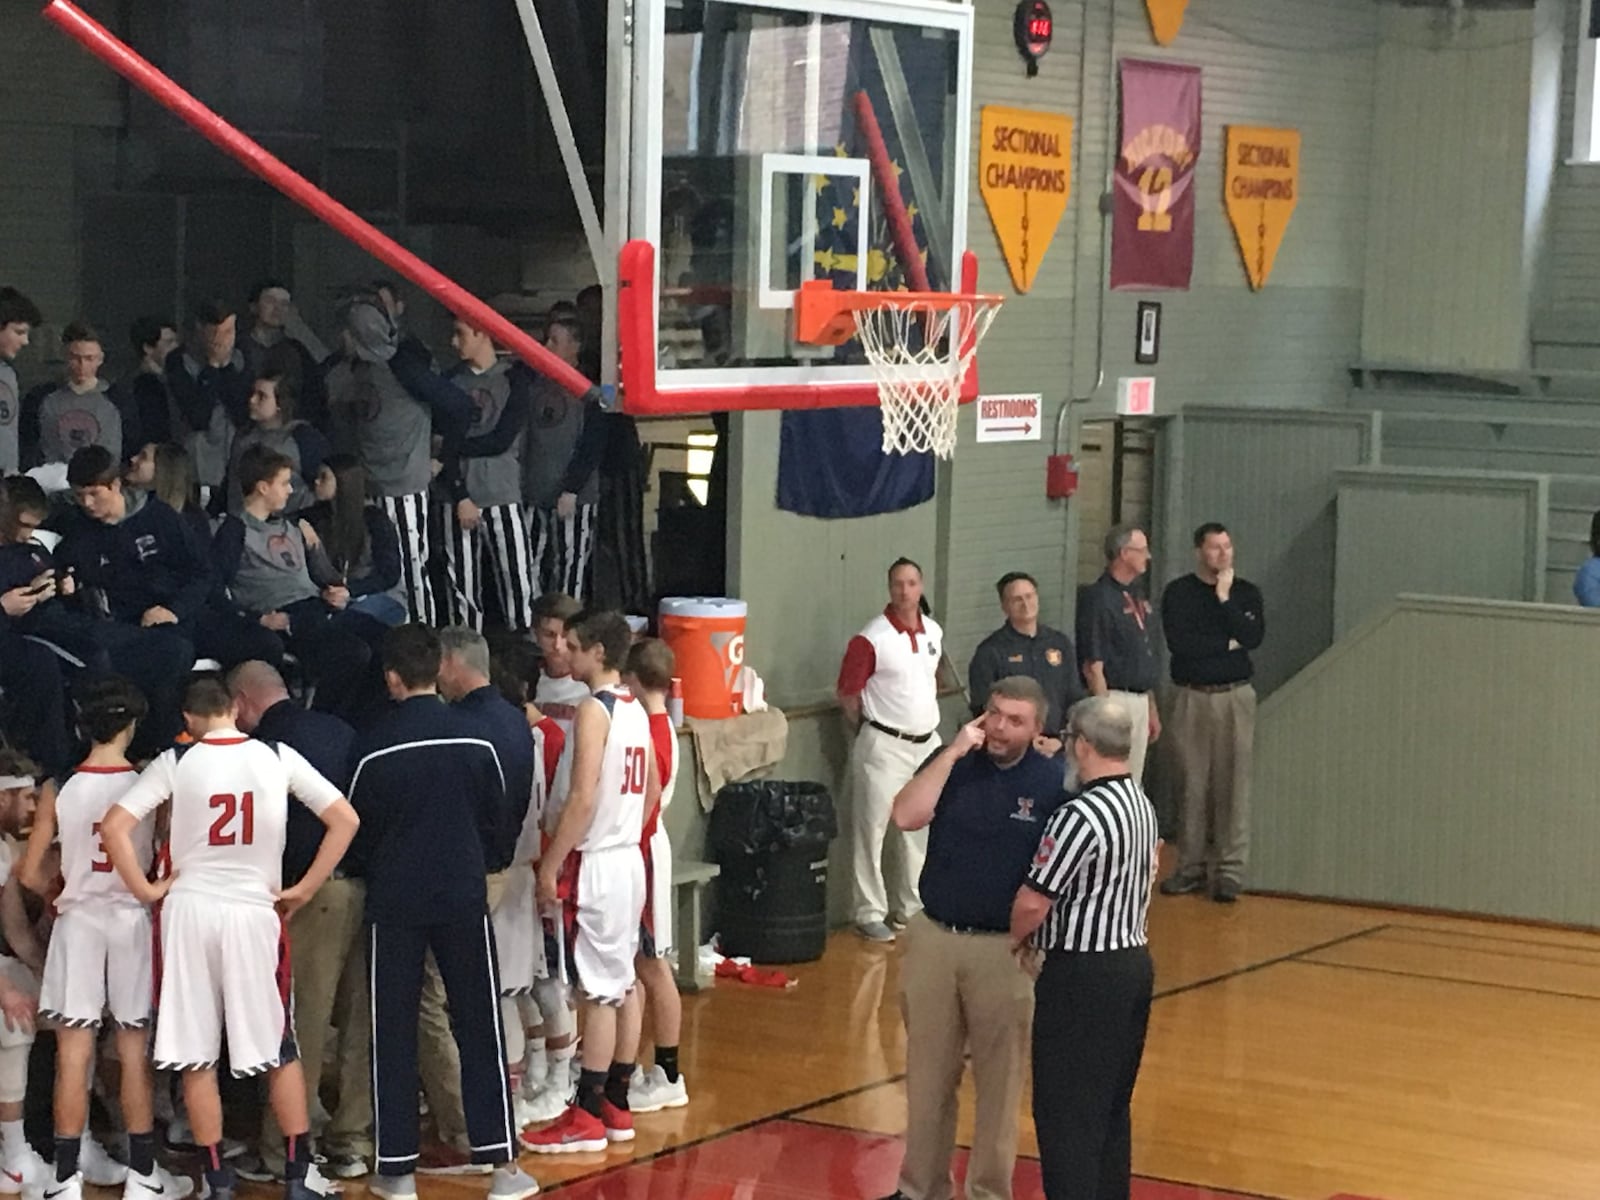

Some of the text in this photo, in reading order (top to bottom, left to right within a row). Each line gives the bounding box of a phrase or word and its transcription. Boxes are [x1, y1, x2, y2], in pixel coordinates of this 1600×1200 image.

[992, 126, 1061, 157] SECTIONAL
[1238, 142, 1290, 168] SECTIONAL
[986, 162, 1065, 193] CHAMPIONS
[1231, 175, 1293, 200] CHAMPIONS
[981, 398, 1037, 419] RESTROOMS
[728, 634, 744, 665] G
[620, 747, 645, 795] 50
[208, 791, 254, 846] 21
